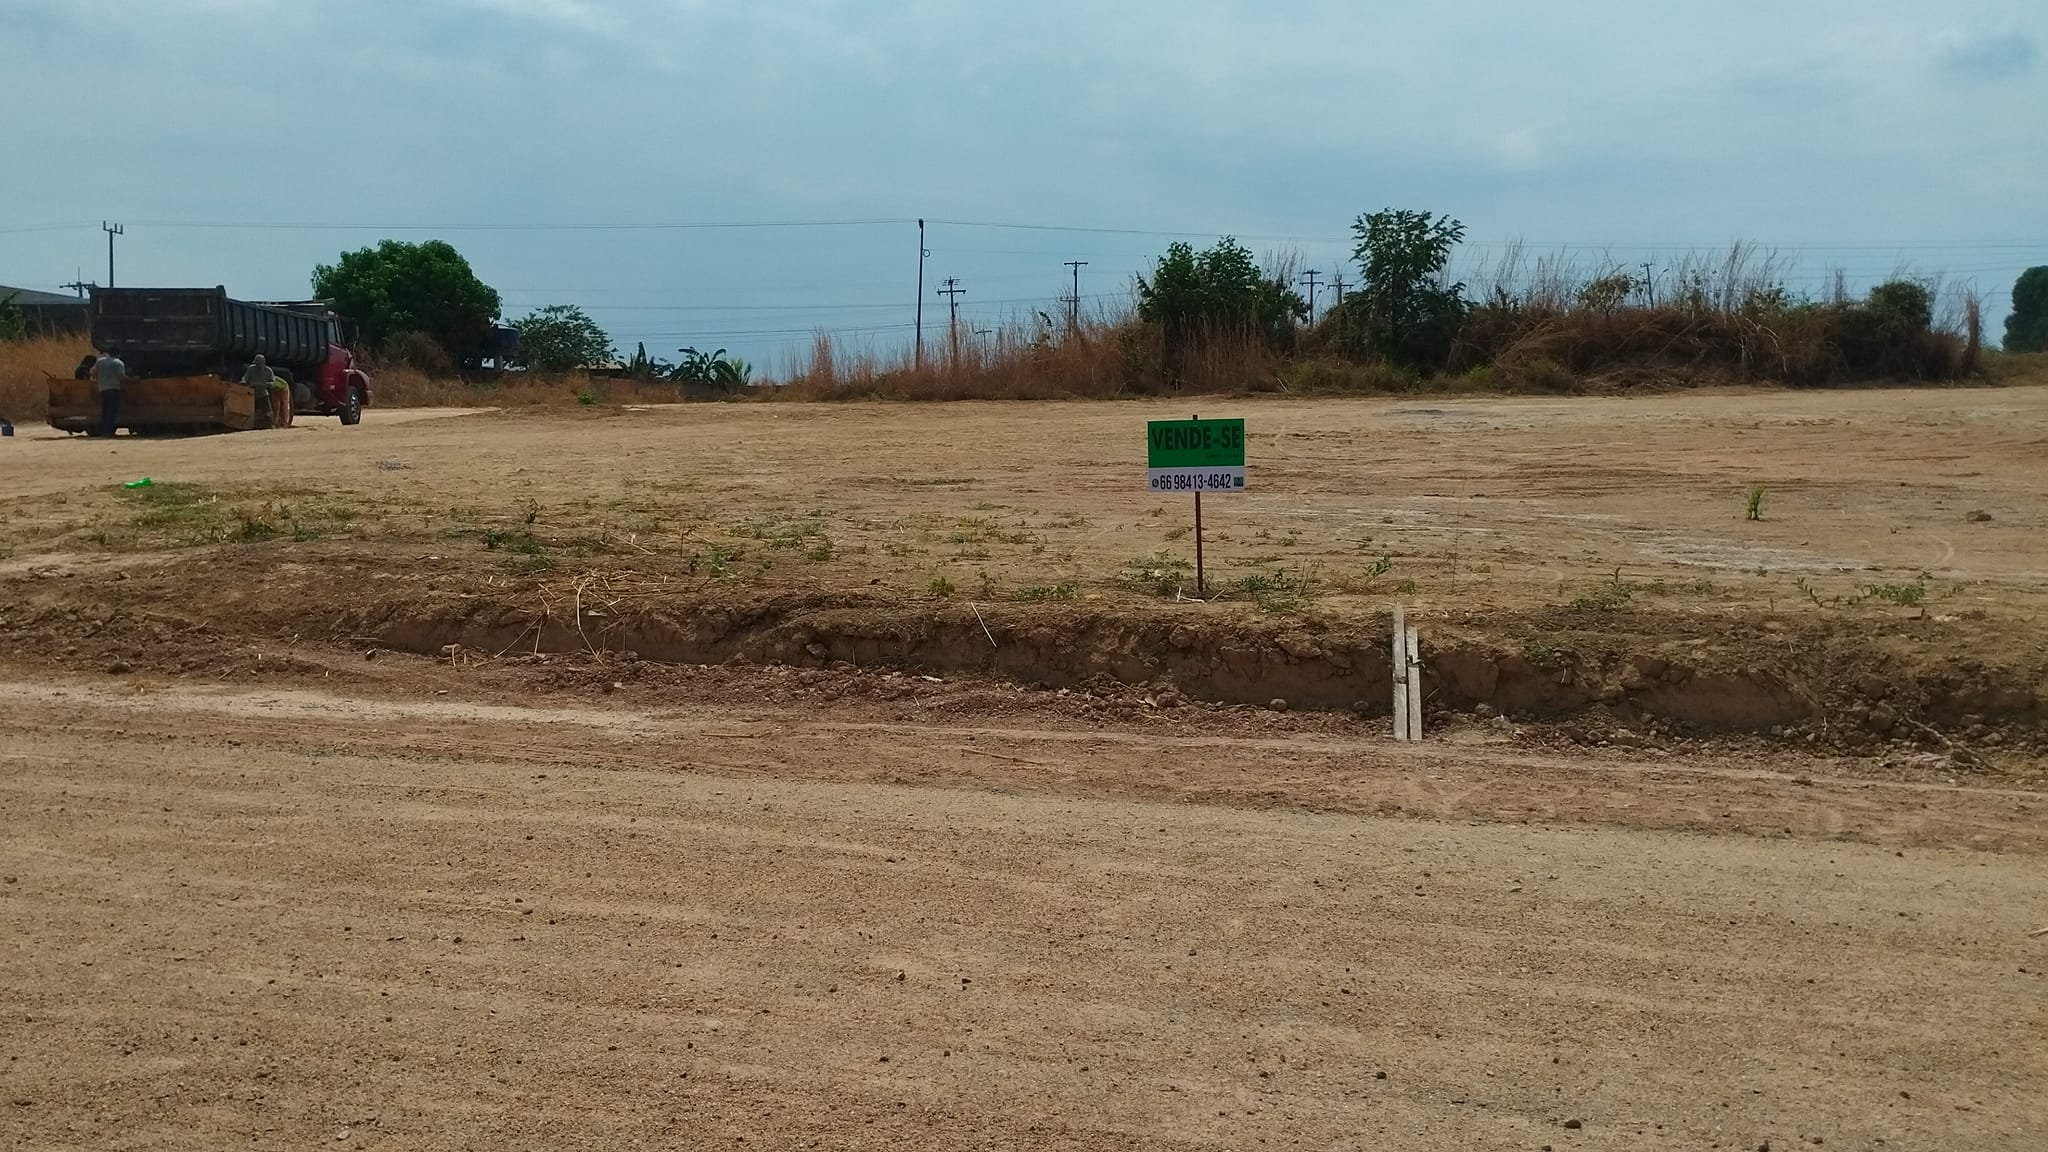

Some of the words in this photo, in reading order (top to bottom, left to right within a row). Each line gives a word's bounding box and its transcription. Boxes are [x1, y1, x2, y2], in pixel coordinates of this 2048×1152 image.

[1152, 425, 1241, 450] VENDE-SE
[1160, 474, 1172, 490] 66
[1174, 473, 1231, 490] 98413-4642
